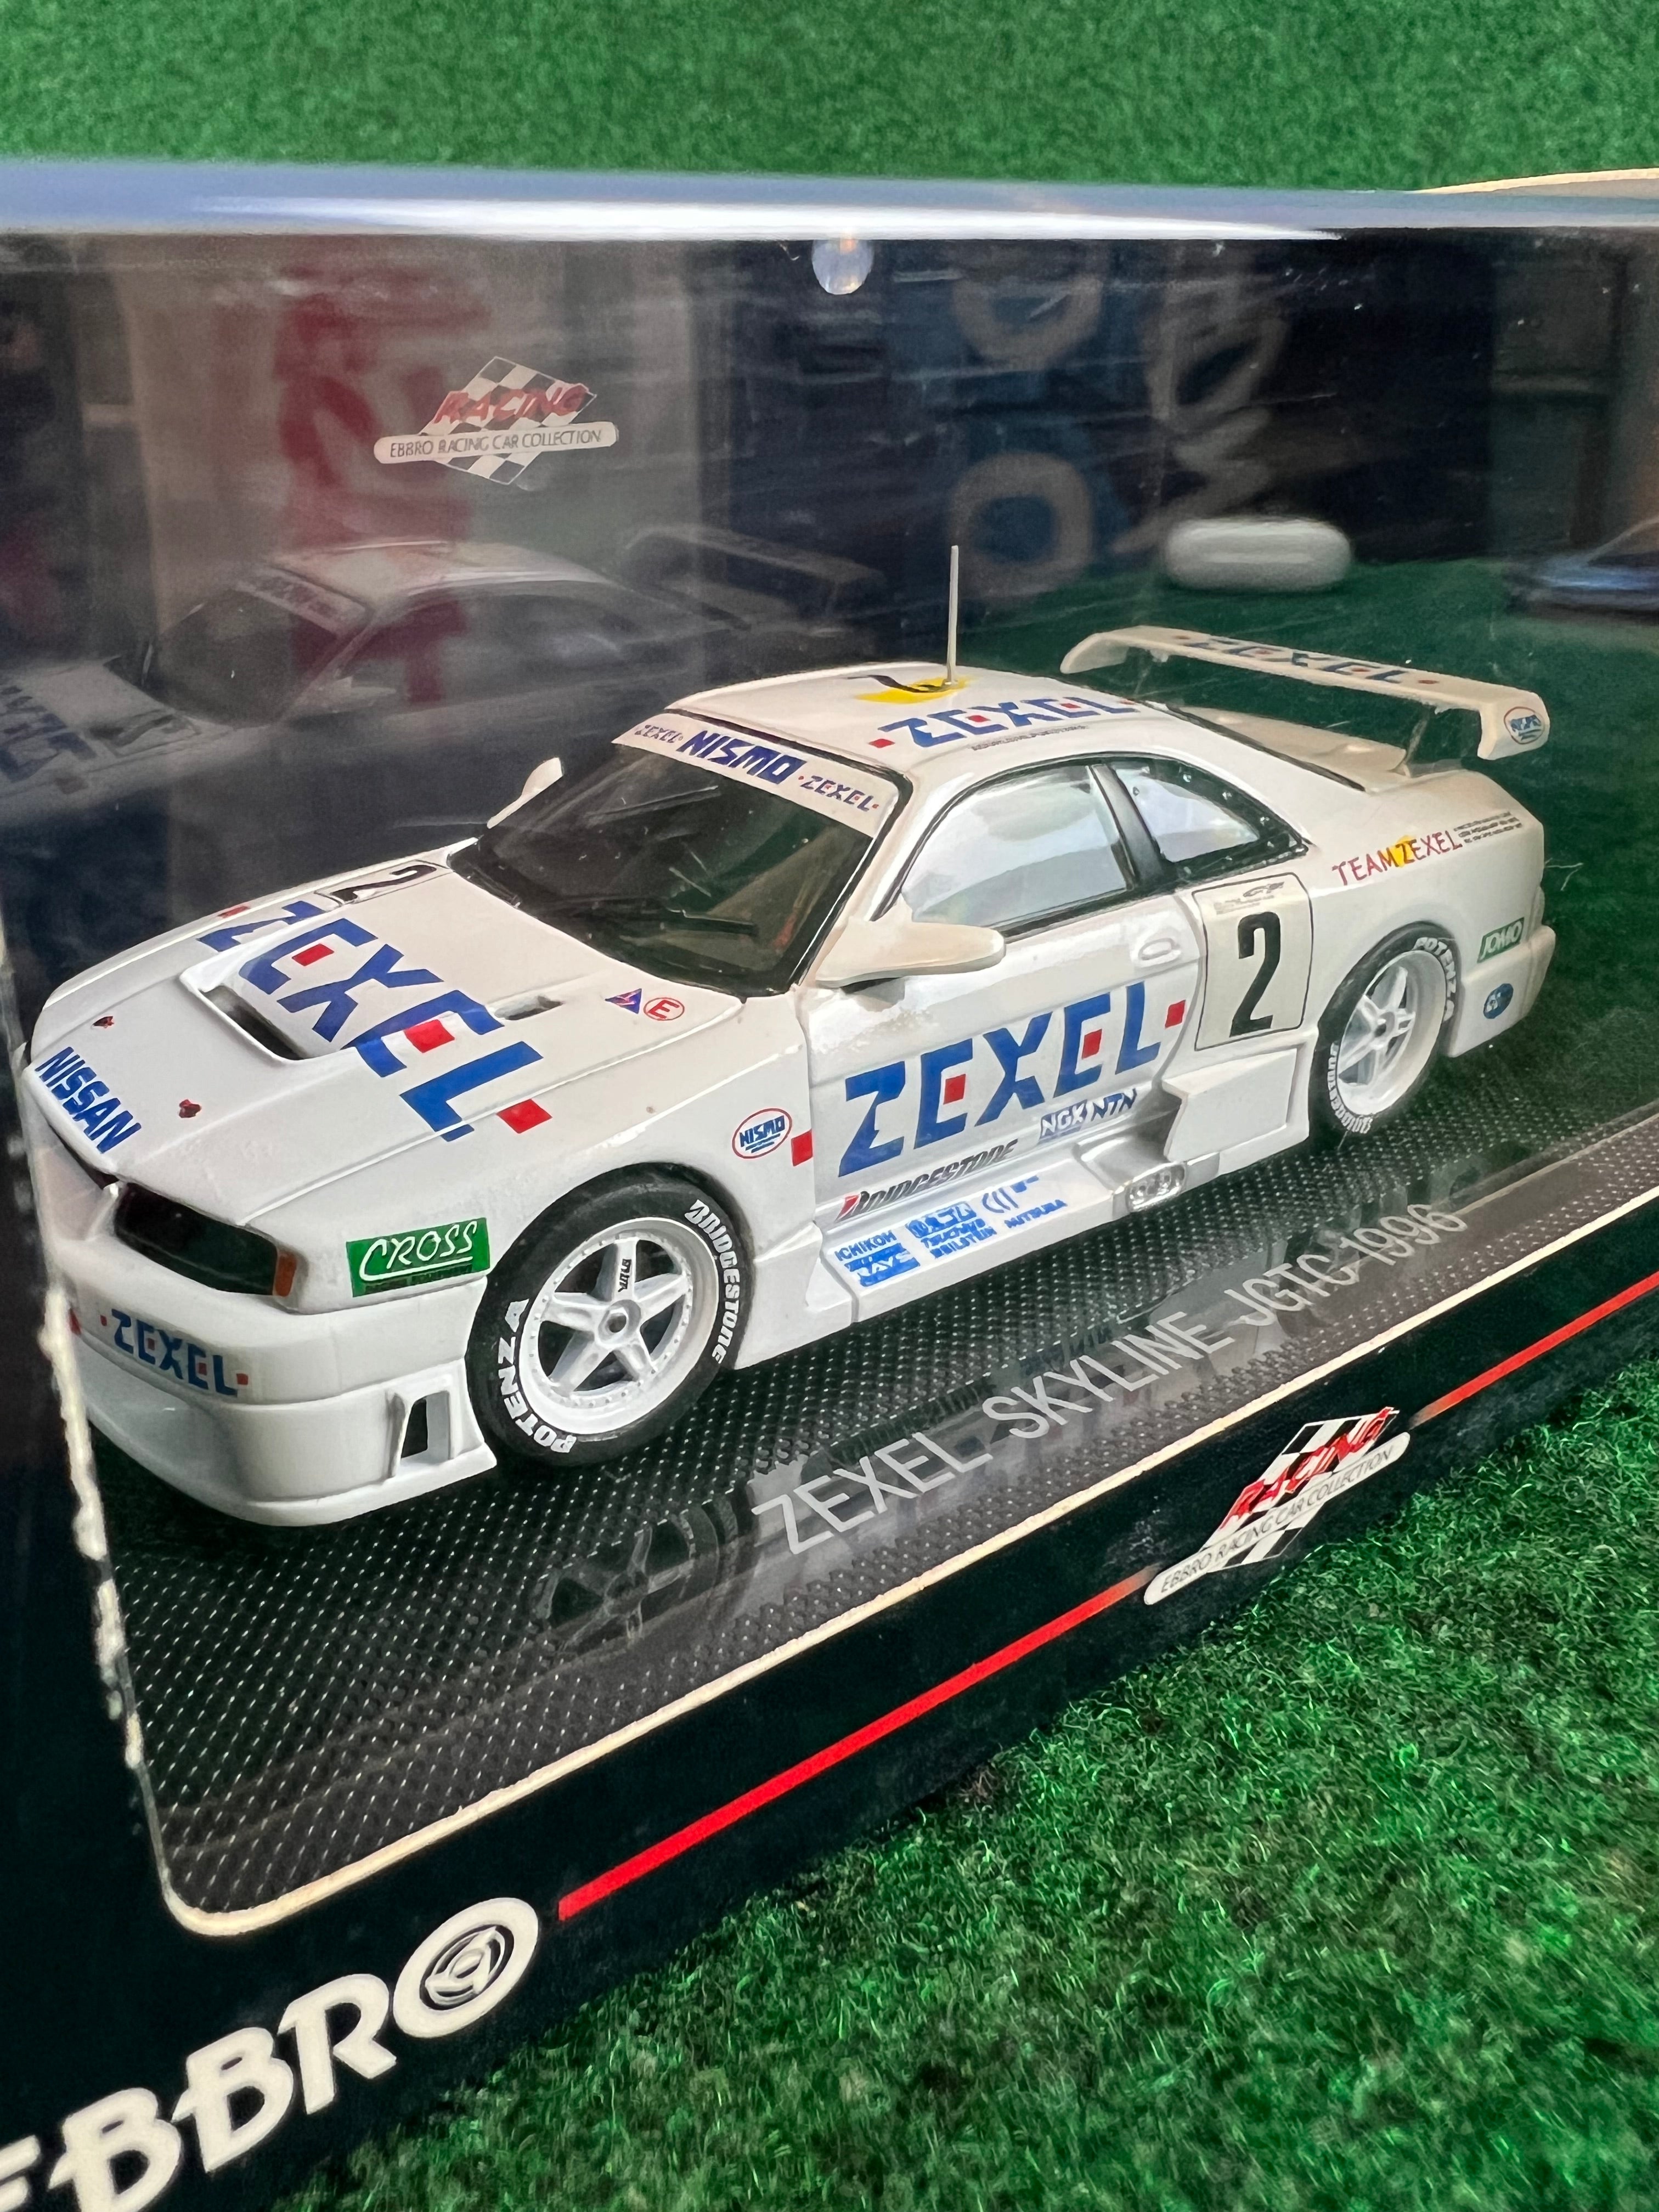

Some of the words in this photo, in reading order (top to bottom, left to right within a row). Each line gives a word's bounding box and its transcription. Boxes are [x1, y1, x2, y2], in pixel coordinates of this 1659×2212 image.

[390, 441, 433, 458] EBBRO
[438, 436, 488, 454] RACING
[493, 433, 519, 449] CAR
[522, 430, 601, 448] COLLECTION
[434, 383, 588, 424] RACING
[878, 696, 1141, 748] ZEXEL
[676, 730, 808, 785] NISMO
[800, 775, 872, 812] ZEXEL
[330, 865, 437, 902] 2
[1229, 911, 1281, 1037] 2
[1480, 920, 1523, 960] JOMO
[195, 901, 544, 1142] ZEXEL
[648, 999, 680, 1019] E
[35, 1046, 142, 1154] NISSAN
[838, 981, 1162, 1177] ZEXEL
[1091, 1087, 1137, 1121] NTN
[739, 1115, 786, 1148] NISMO
[359, 1221, 477, 1281] CROSS
[684, 1199, 741, 1364] BRIDGESTONE
[111, 1308, 238, 1397] ZEXEL
[498, 1299, 577, 1453] POTENZA
[752, 1431, 992, 1554] ZEXEL
[983, 1312, 1234, 1439] SKYLINE
[1224, 1254, 1360, 1326] JGTC
[1339, 1204, 1468, 1266] 1996
[1219, 1407, 1395, 1530] RACING
[1161, 1553, 1212, 1593] EBBRO
[1216, 1515, 1274, 1559] RACING
[1276, 1497, 1303, 1526] CAR
[1306, 1449, 1394, 1506] COLLECTION
